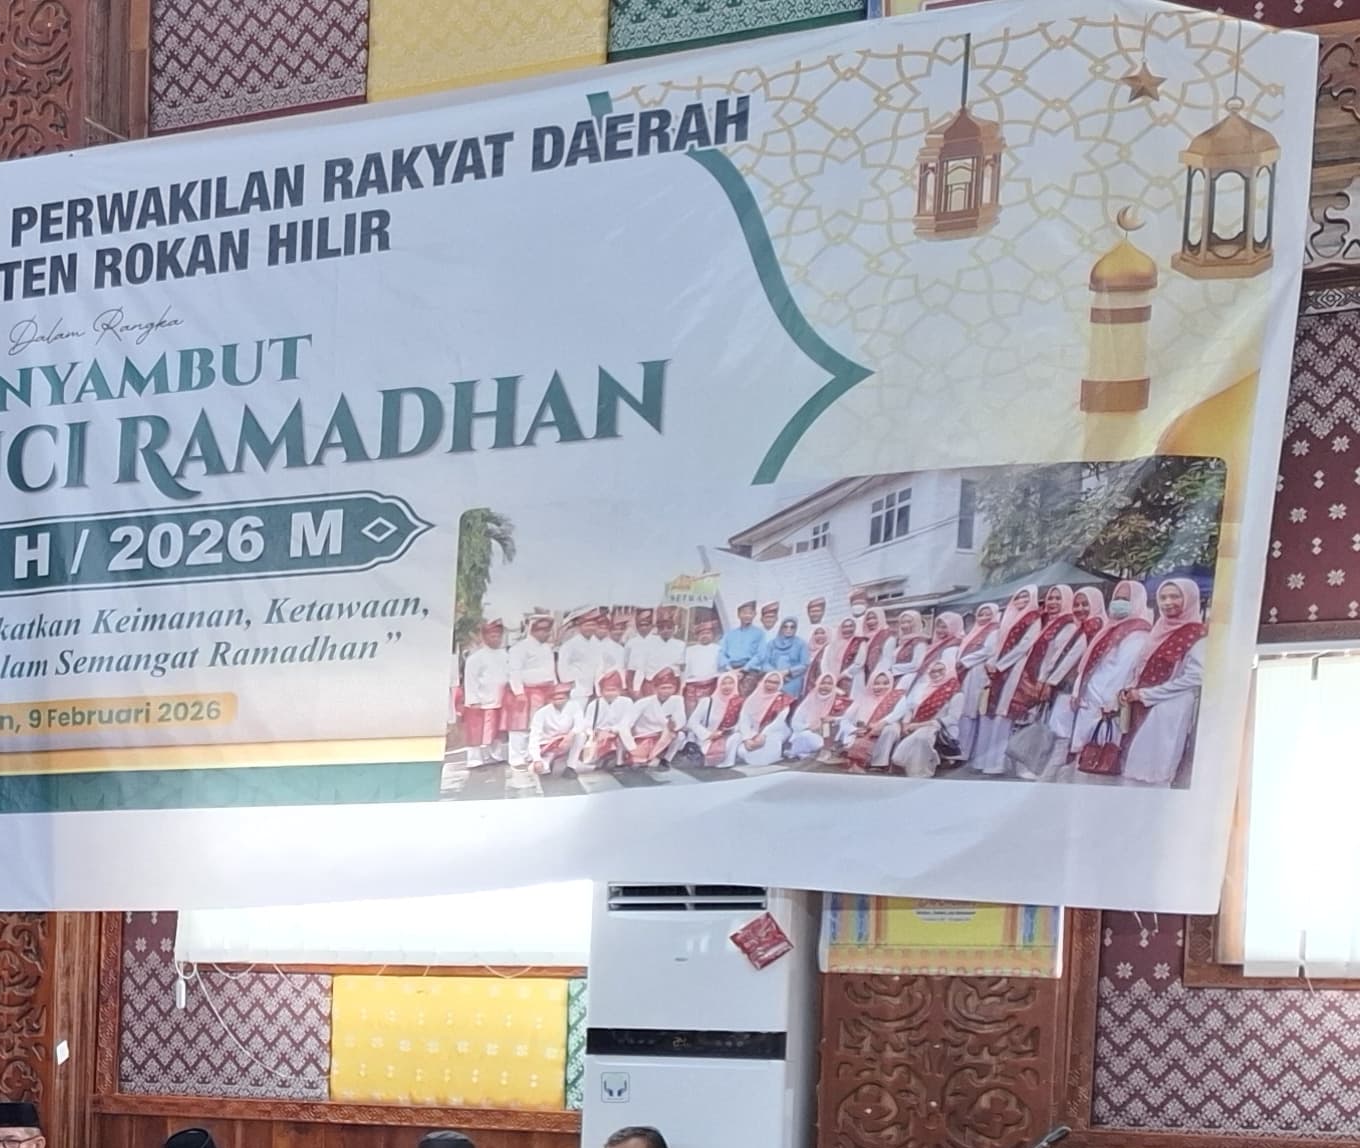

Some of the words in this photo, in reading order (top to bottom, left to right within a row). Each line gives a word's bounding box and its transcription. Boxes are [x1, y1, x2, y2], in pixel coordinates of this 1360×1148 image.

[11, 164, 305, 248] PERWAKILAN
[322, 132, 514, 201] RAKYAT
[531, 95, 750, 172] DAERAH
[94, 229, 250, 289] ROKAN
[267, 210, 391, 266] HILIR
[8, 317, 85, 356] Dalam
[92, 306, 185, 346] Rangka
[113, 359, 671, 498] RAMADHAN
[13, 531, 50, 579] H
[108, 517, 264, 572] 2026
[289, 509, 344, 558] M
[91, 604, 252, 635] Keimanan,
[264, 594, 430, 625] Ketawaan,
[56, 648, 200, 678] Semangat
[29, 708, 42, 728] 9
[47, 702, 151, 727] Februari
[157, 700, 222, 723] 2026
